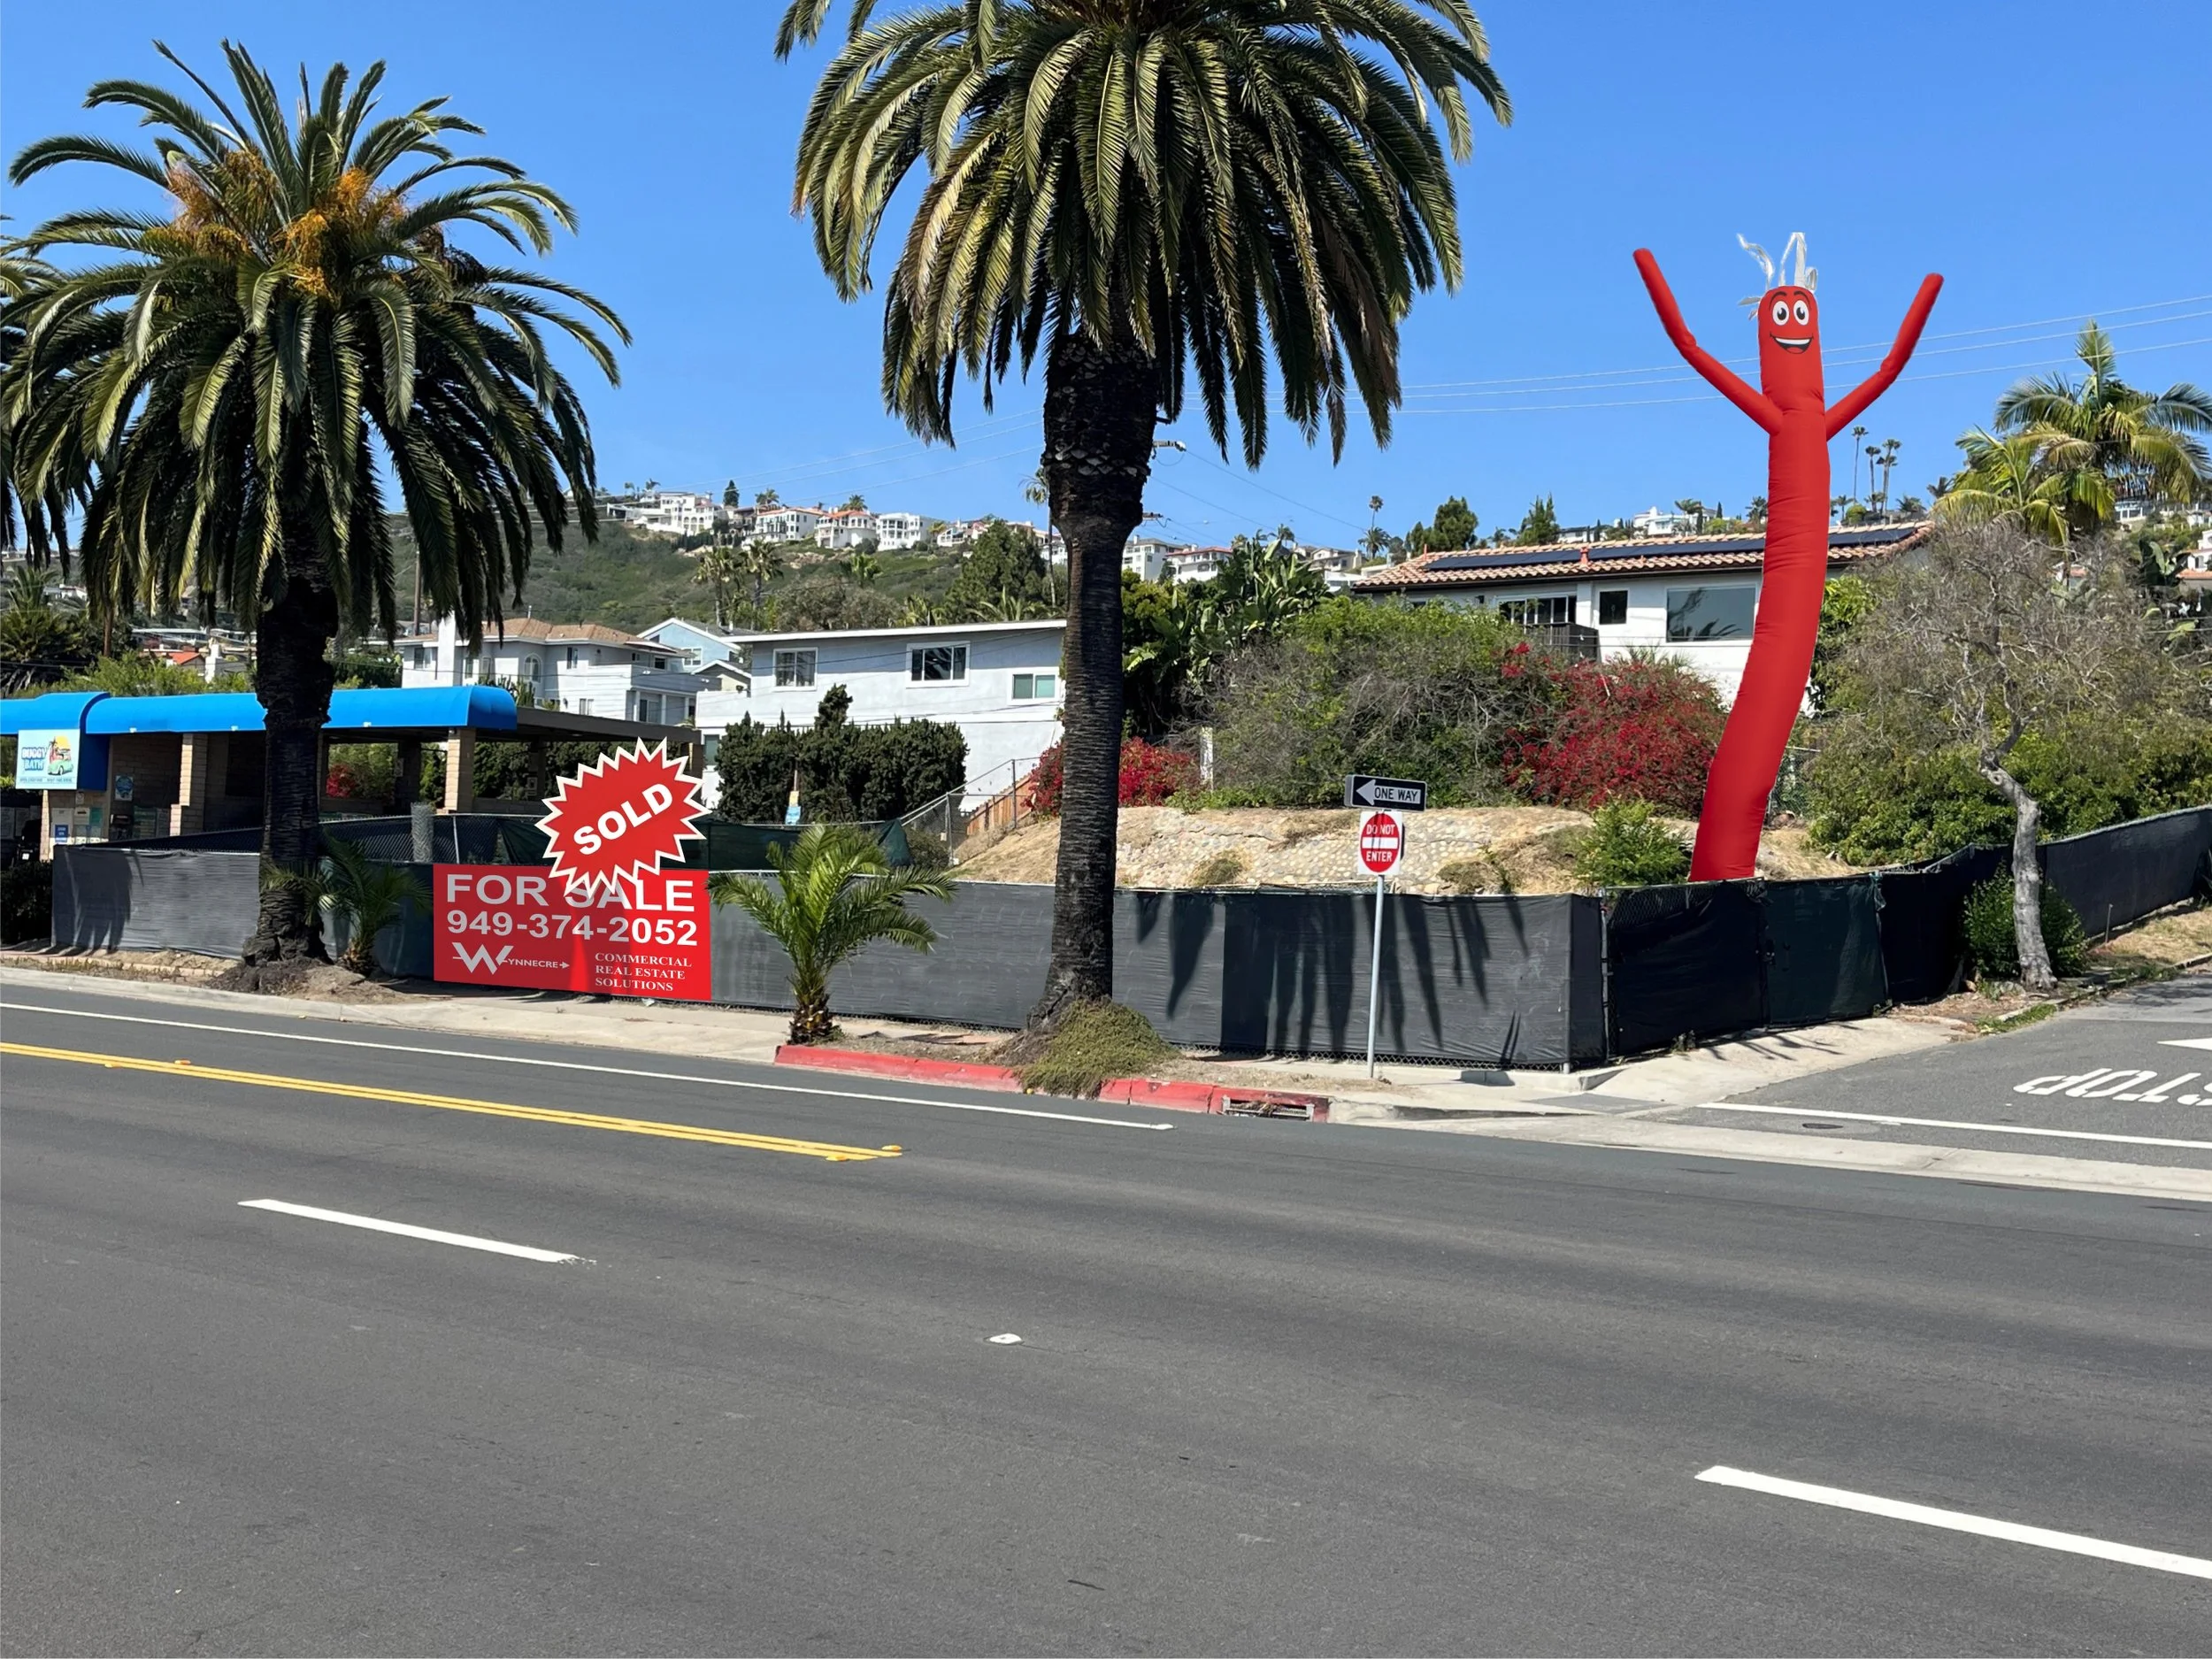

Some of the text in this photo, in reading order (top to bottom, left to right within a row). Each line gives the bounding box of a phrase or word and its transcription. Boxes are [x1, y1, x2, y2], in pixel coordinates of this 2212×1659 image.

[21, 747, 46, 759] BUGGY
[24, 758, 44, 771] BATH
[1374, 787, 1418, 802] ONE WAY
[573, 783, 673, 856] SOLD
[1366, 824, 1395, 834] DO NOT
[1366, 851, 1393, 862] ENTER
[447, 874, 549, 907] FOR
[447, 910, 698, 946] 949-374-2052
[595, 952, 693, 967] COMMERCIAL
[595, 964, 686, 979] REAL ESTATE
[595, 978, 673, 991] SOLUTIONS
